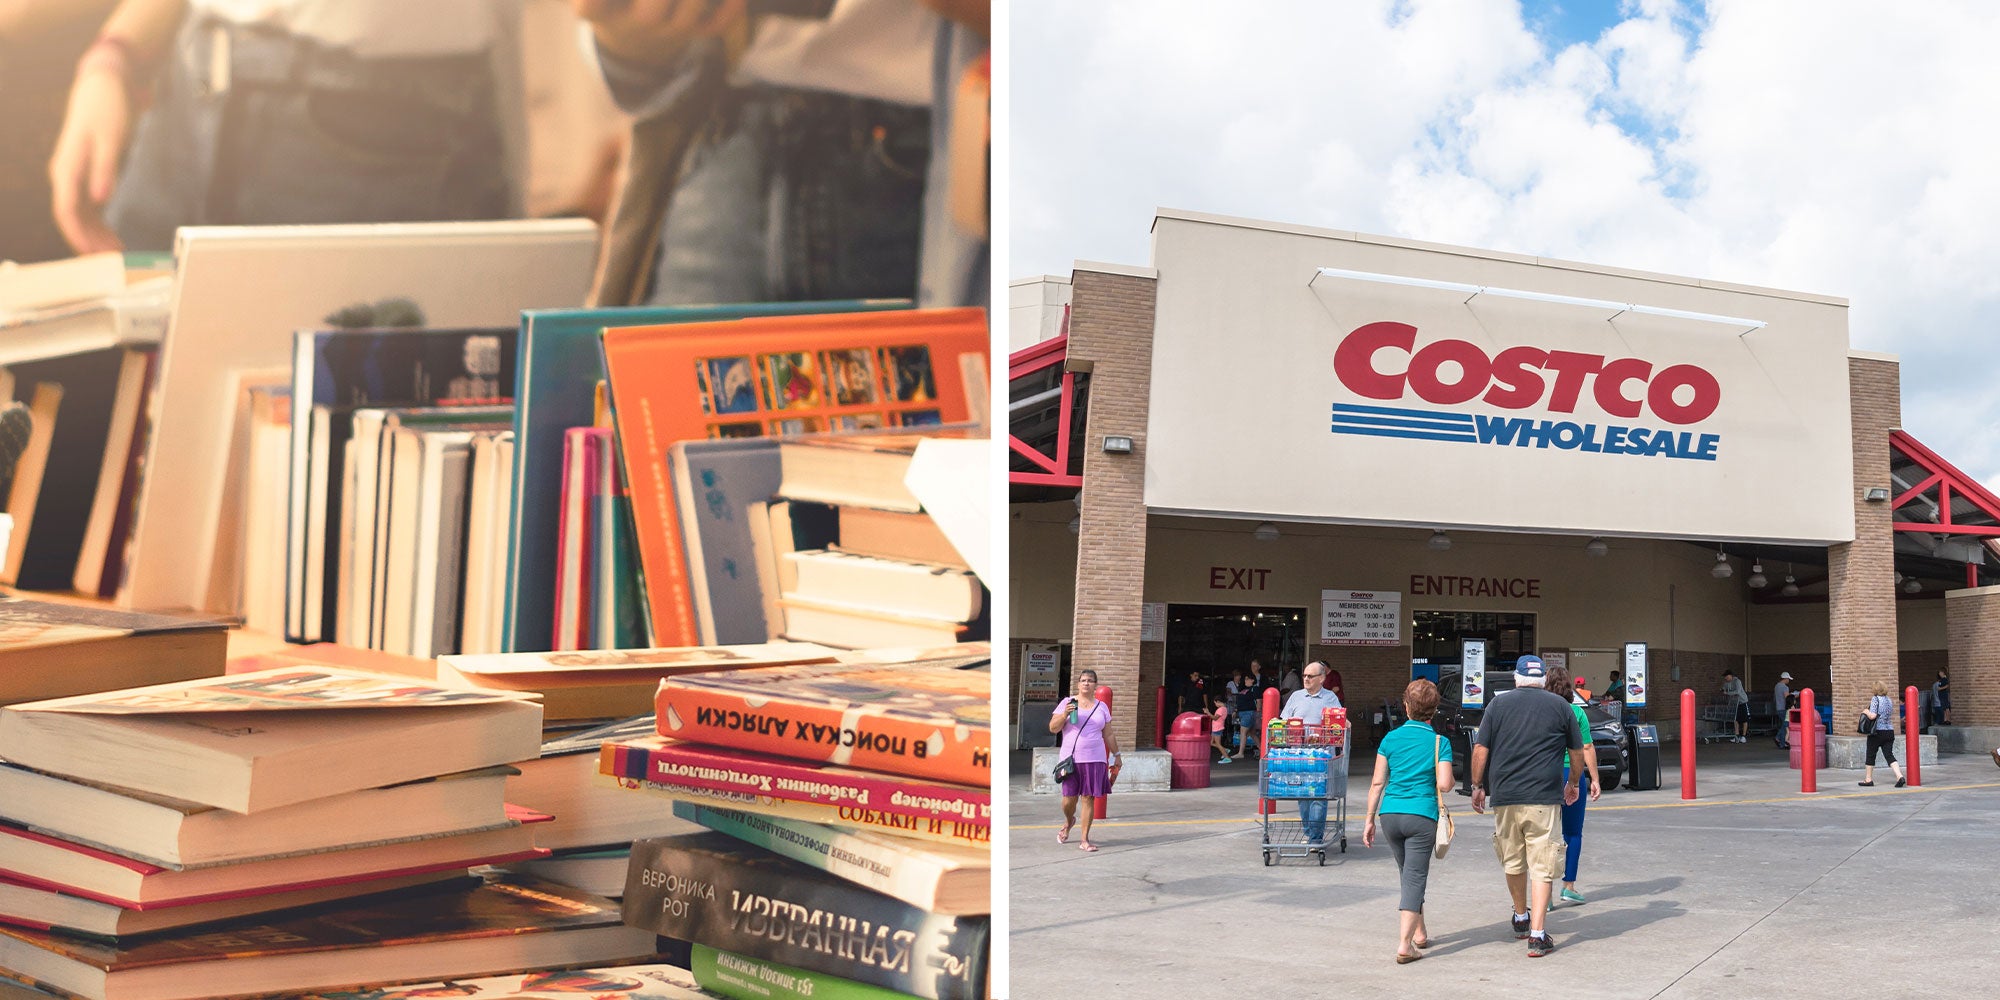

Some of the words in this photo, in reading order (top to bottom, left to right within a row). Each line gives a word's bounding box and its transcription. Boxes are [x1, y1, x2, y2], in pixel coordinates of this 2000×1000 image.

[1333, 321, 1721, 425] COSTCO
[1474, 414, 1720, 461] WHOLESALE
[1210, 567, 1271, 590] EXIT
[1410, 575, 1540, 598] ENTRANCE
[697, 706, 789, 737] АЛЯСКИ
[795, 721, 906, 755] ПОИСКАХ
[913, 740, 927, 758] В
[657, 760, 772, 791] Хотценплотц
[776, 777, 869, 804] Разбойник
[891, 791, 976, 819] Пройслер
[748, 816, 829, 855] ПРОФЕССИОНАЛЬНОГО
[831, 845, 891, 878] ПРИКЛЮЧЕНИЯ
[642, 868, 715, 901] ВЕРОНИКА
[663, 897, 689, 918] РОТ
[730, 890, 916, 973] ИЗБРАННАЯ
[717, 952, 760, 977] ЖЖИЗНИ
[760, 964, 796, 990] ЭПИЗОД
[797, 978, 814, 996] 151
